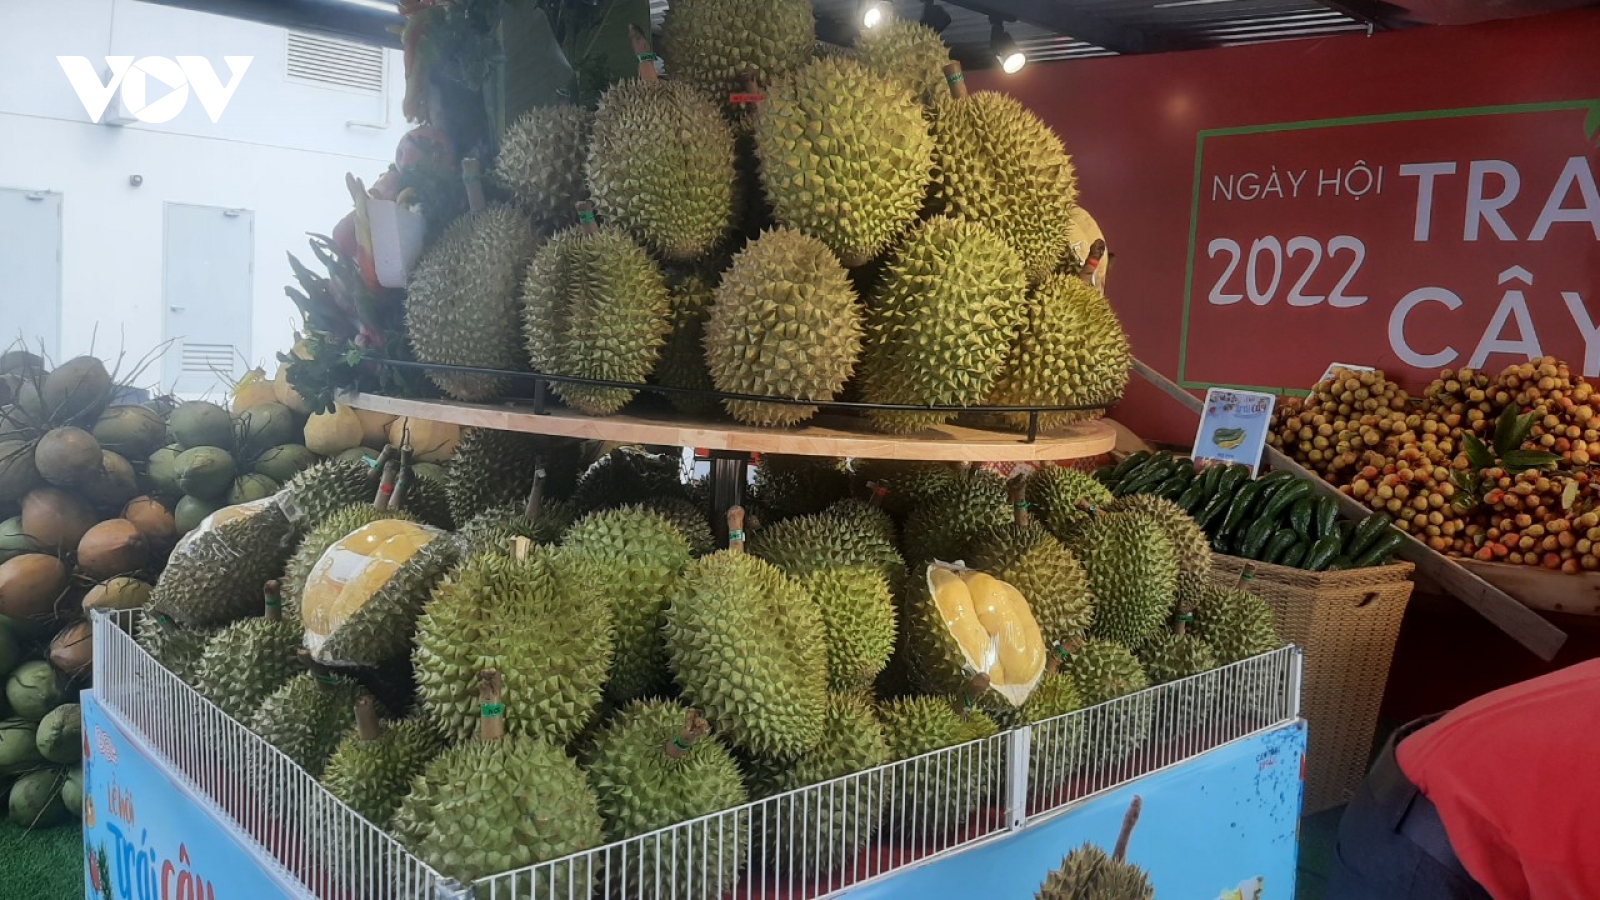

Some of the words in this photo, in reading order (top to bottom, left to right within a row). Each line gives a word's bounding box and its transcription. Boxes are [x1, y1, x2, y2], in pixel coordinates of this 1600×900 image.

[1212, 165, 1307, 201] NGÀY
[1317, 159, 1383, 201] HỘI
[1208, 235, 1369, 308] 2022
[1388, 264, 1600, 377] CÂY
[106, 821, 159, 900] Trái
